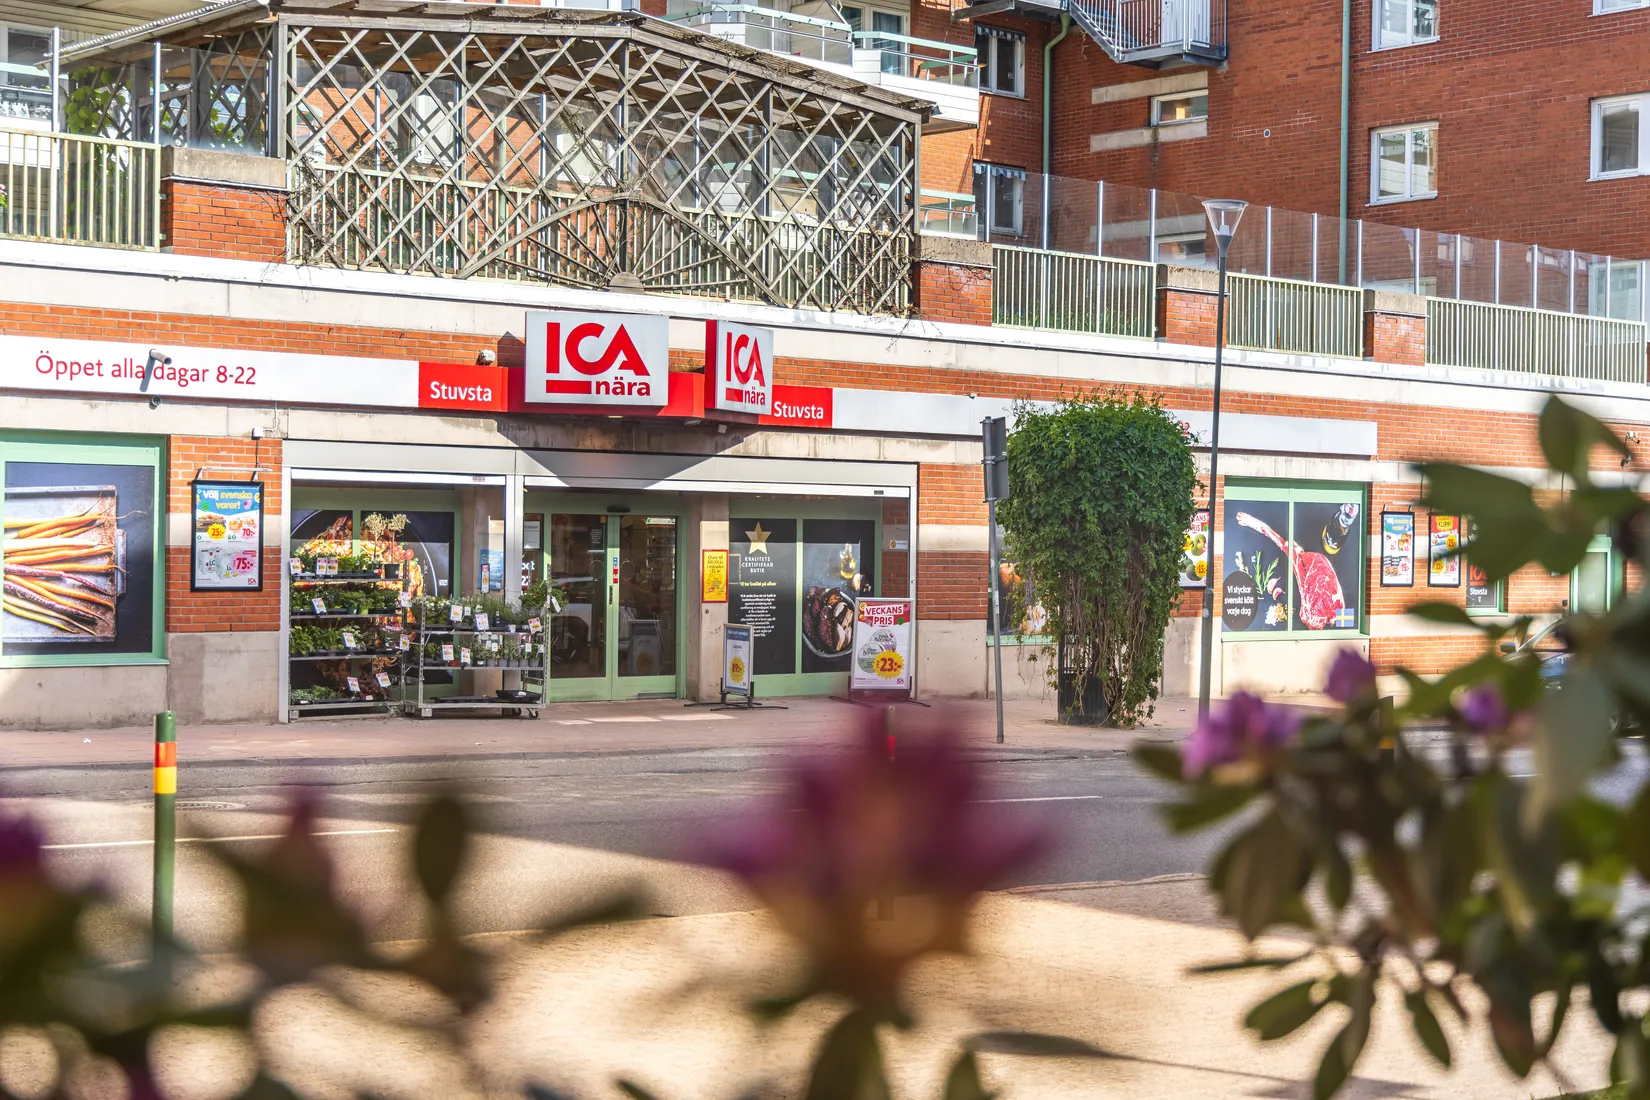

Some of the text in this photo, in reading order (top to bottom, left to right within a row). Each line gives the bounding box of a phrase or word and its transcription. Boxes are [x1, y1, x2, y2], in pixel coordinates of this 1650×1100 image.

[545, 321, 651, 376] ICA
[725, 331, 766, 387] ICA
[35, 350, 257, 388] Öppet alla dagar 8-22
[430, 381, 492, 402] Stuvsta
[595, 376, 651, 397] nära
[744, 387, 766, 406] nära
[773, 400, 824, 419] Stuvsta
[203, 490, 253, 501] Välj svenska
[216, 501, 241, 509] varor!
[236, 557, 254, 570] 75:-
[1226, 585, 1252, 595] Vi styckar
[1469, 587, 1488, 596] Stuvsta
[1224, 595, 1254, 604] svenskt kött
[865, 606, 903, 616] VECKANS
[1226, 606, 1252, 617] varje dag
[873, 616, 893, 626] PRIS
[879, 657, 902, 672] 23:-
